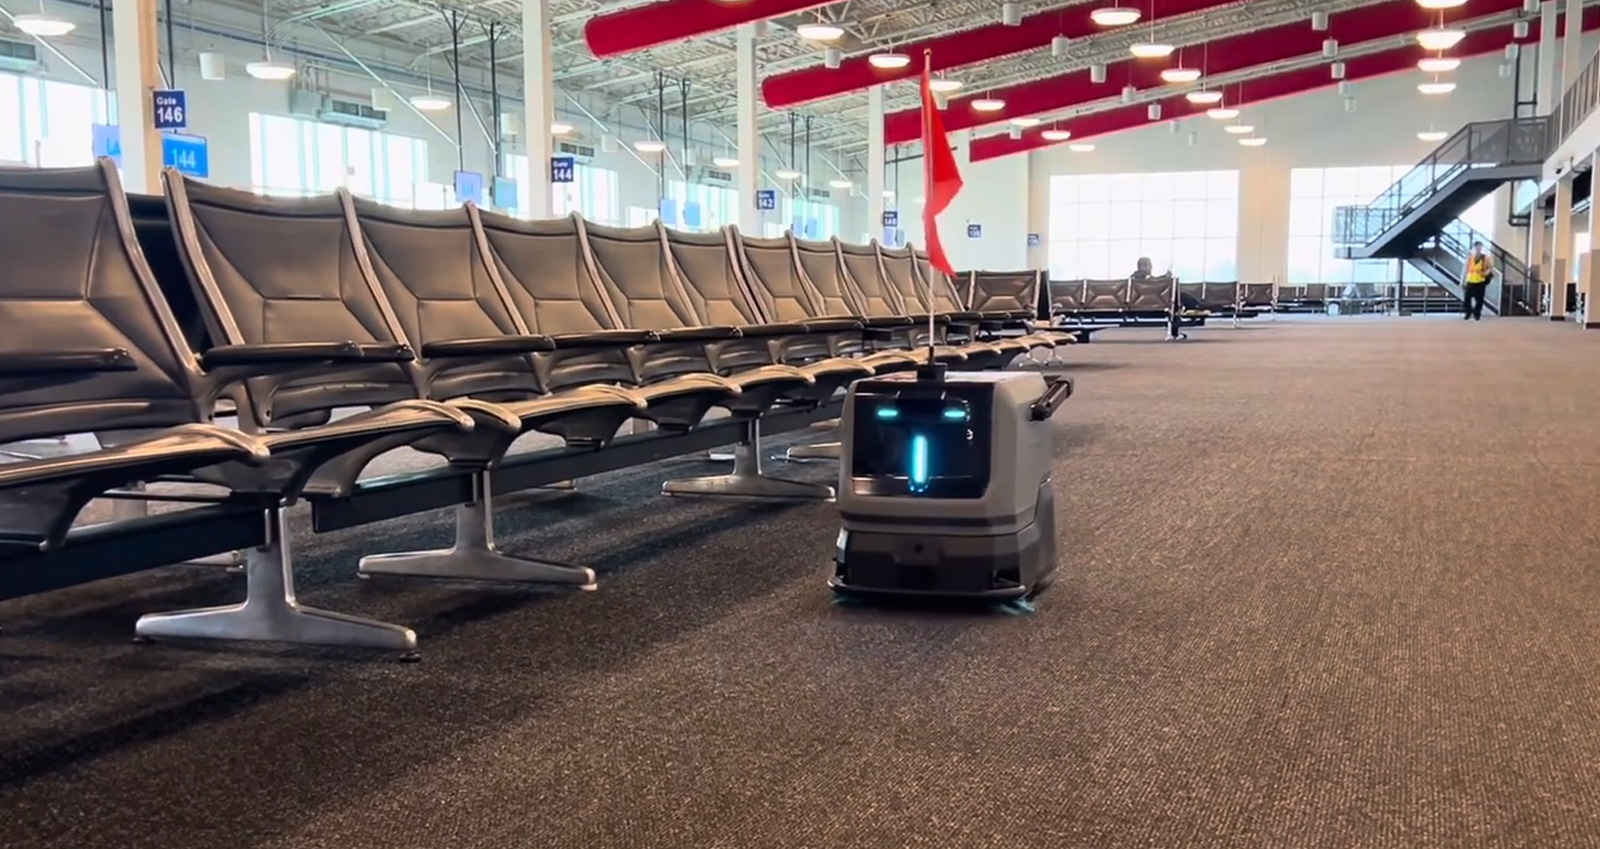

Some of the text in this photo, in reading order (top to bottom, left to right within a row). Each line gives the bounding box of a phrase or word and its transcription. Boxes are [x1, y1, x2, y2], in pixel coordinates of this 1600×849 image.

[156, 96, 177, 105] Gate
[157, 106, 183, 123] 146
[171, 148, 196, 168] 144
[554, 168, 571, 180] 144
